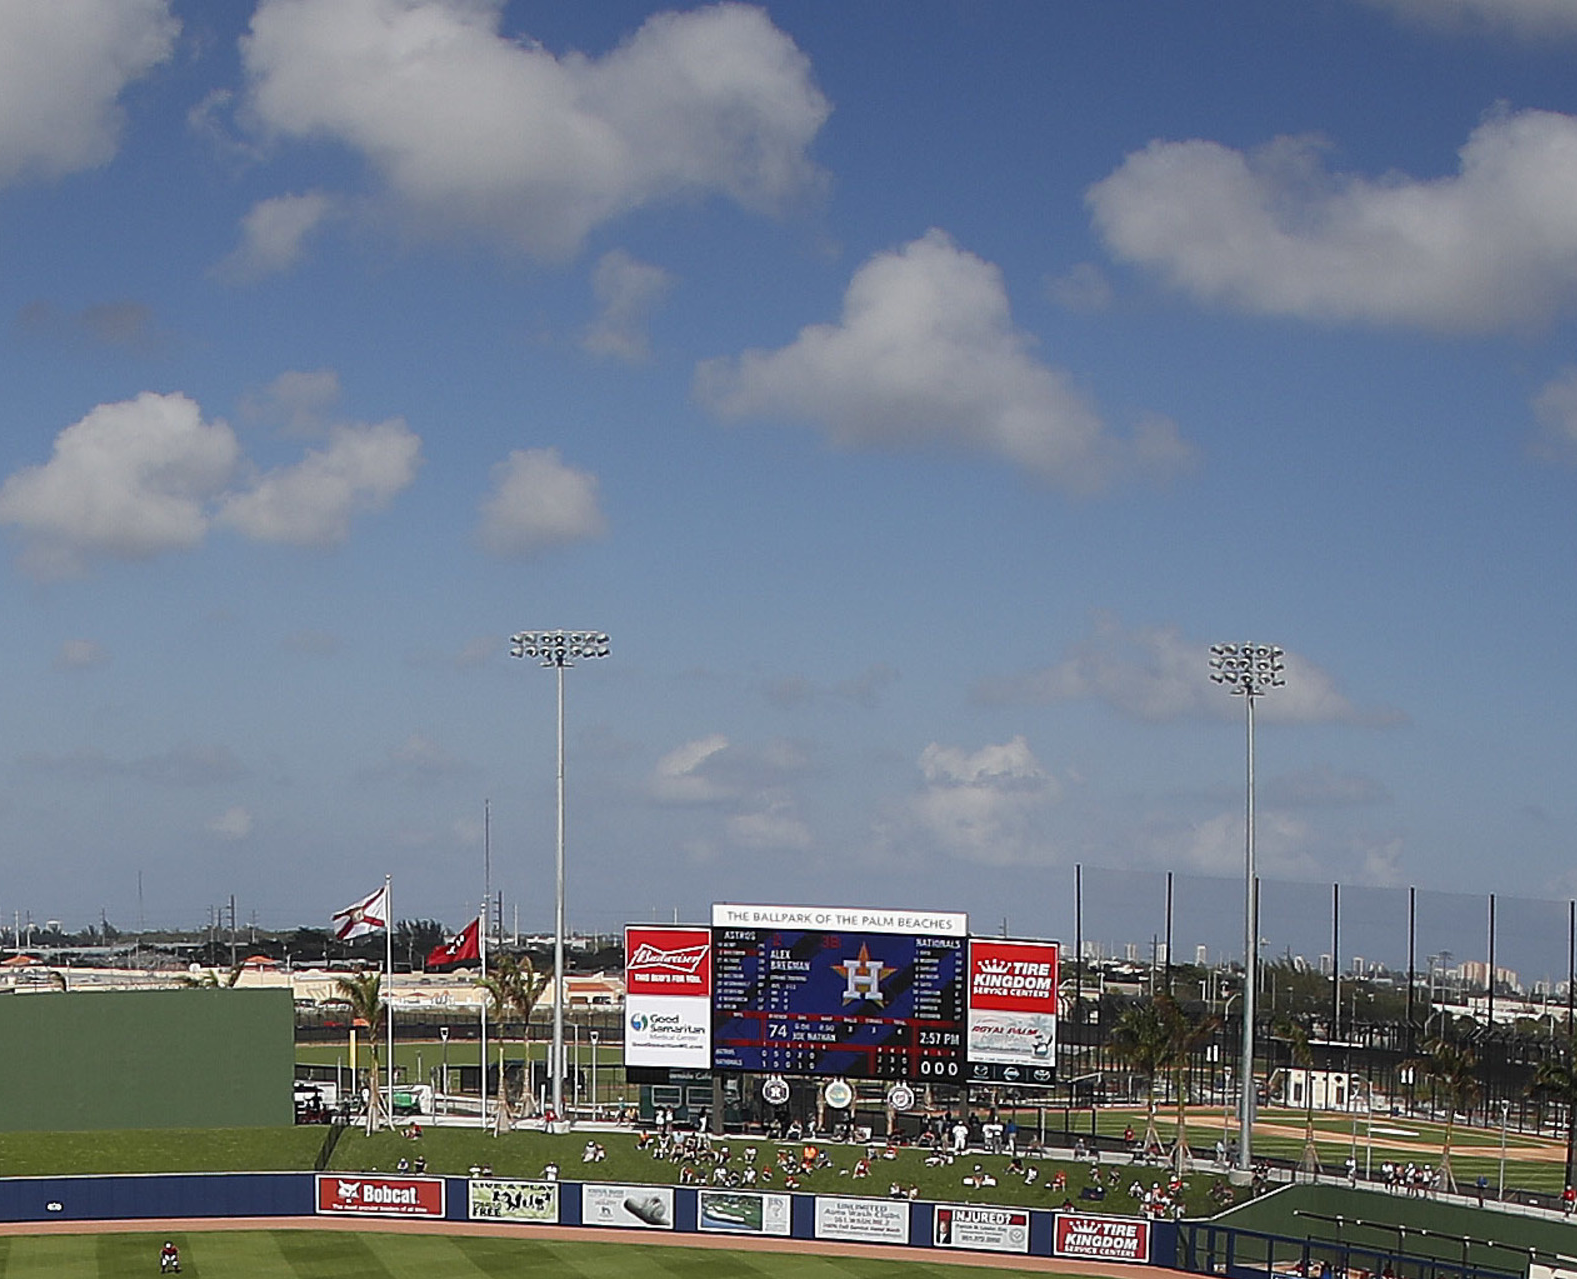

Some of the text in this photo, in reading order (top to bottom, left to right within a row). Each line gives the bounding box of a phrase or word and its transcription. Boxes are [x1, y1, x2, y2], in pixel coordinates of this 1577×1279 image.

[727, 911, 953, 930] THE BALLPARK OF THE PALM BEACHES
[634, 949, 701, 964] Budweiser
[770, 950, 791, 960] ALEX
[1013, 962, 1051, 976] TIRE
[973, 973, 1052, 990] KINGDOM
[973, 986, 1050, 998] SERVICE CENTERS
[649, 1013, 680, 1024] Good
[650, 1024, 706, 1034] Samaritan
[768, 1024, 787, 1038] 74
[971, 1026, 1004, 1034] ROYAL
[920, 1032, 960, 1045] 2:57 PM
[921, 1061, 958, 1076] 0 0 0
[363, 1184, 417, 1204] Bobcat
[952, 1209, 1012, 1225] INJURED?
[1102, 1223, 1137, 1237] TIRE
[1065, 1233, 1139, 1251] KINGDOM
[1064, 1244, 1136, 1257] SERVICE CENTERS
